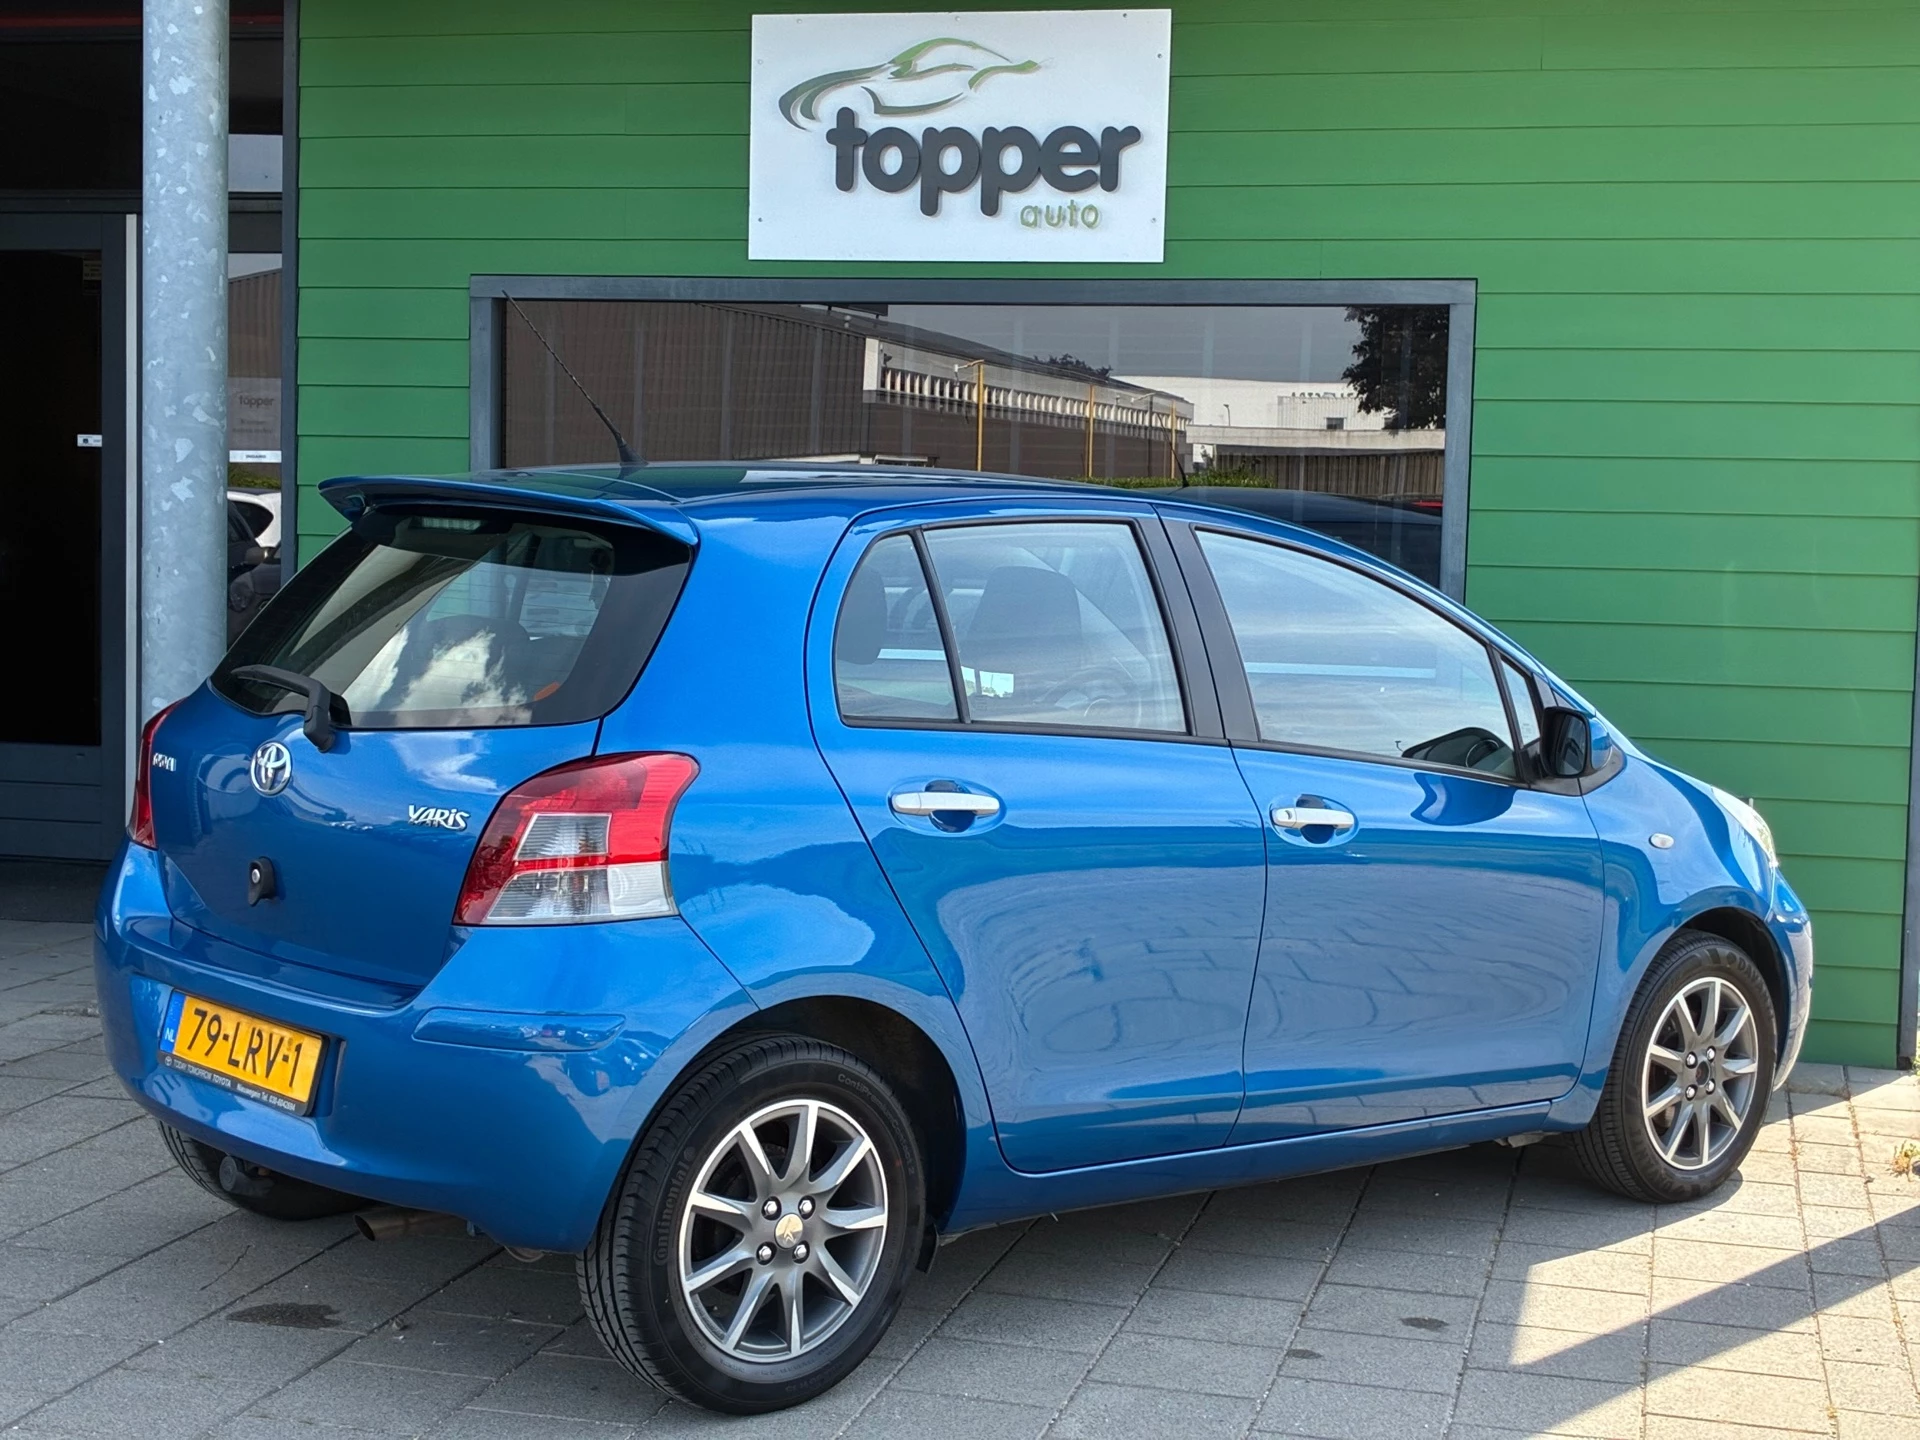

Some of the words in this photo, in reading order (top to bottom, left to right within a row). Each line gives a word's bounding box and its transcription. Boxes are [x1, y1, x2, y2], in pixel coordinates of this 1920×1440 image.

[826, 107, 1141, 216] topper
[1020, 200, 1099, 228] auto
[239, 395, 275, 408] topper
[164, 1028, 174, 1042] NL
[187, 1008, 303, 1088] 79-LRV-1
[213, 1073, 231, 1088] TOYOTA
[654, 1160, 690, 1265] Continental
